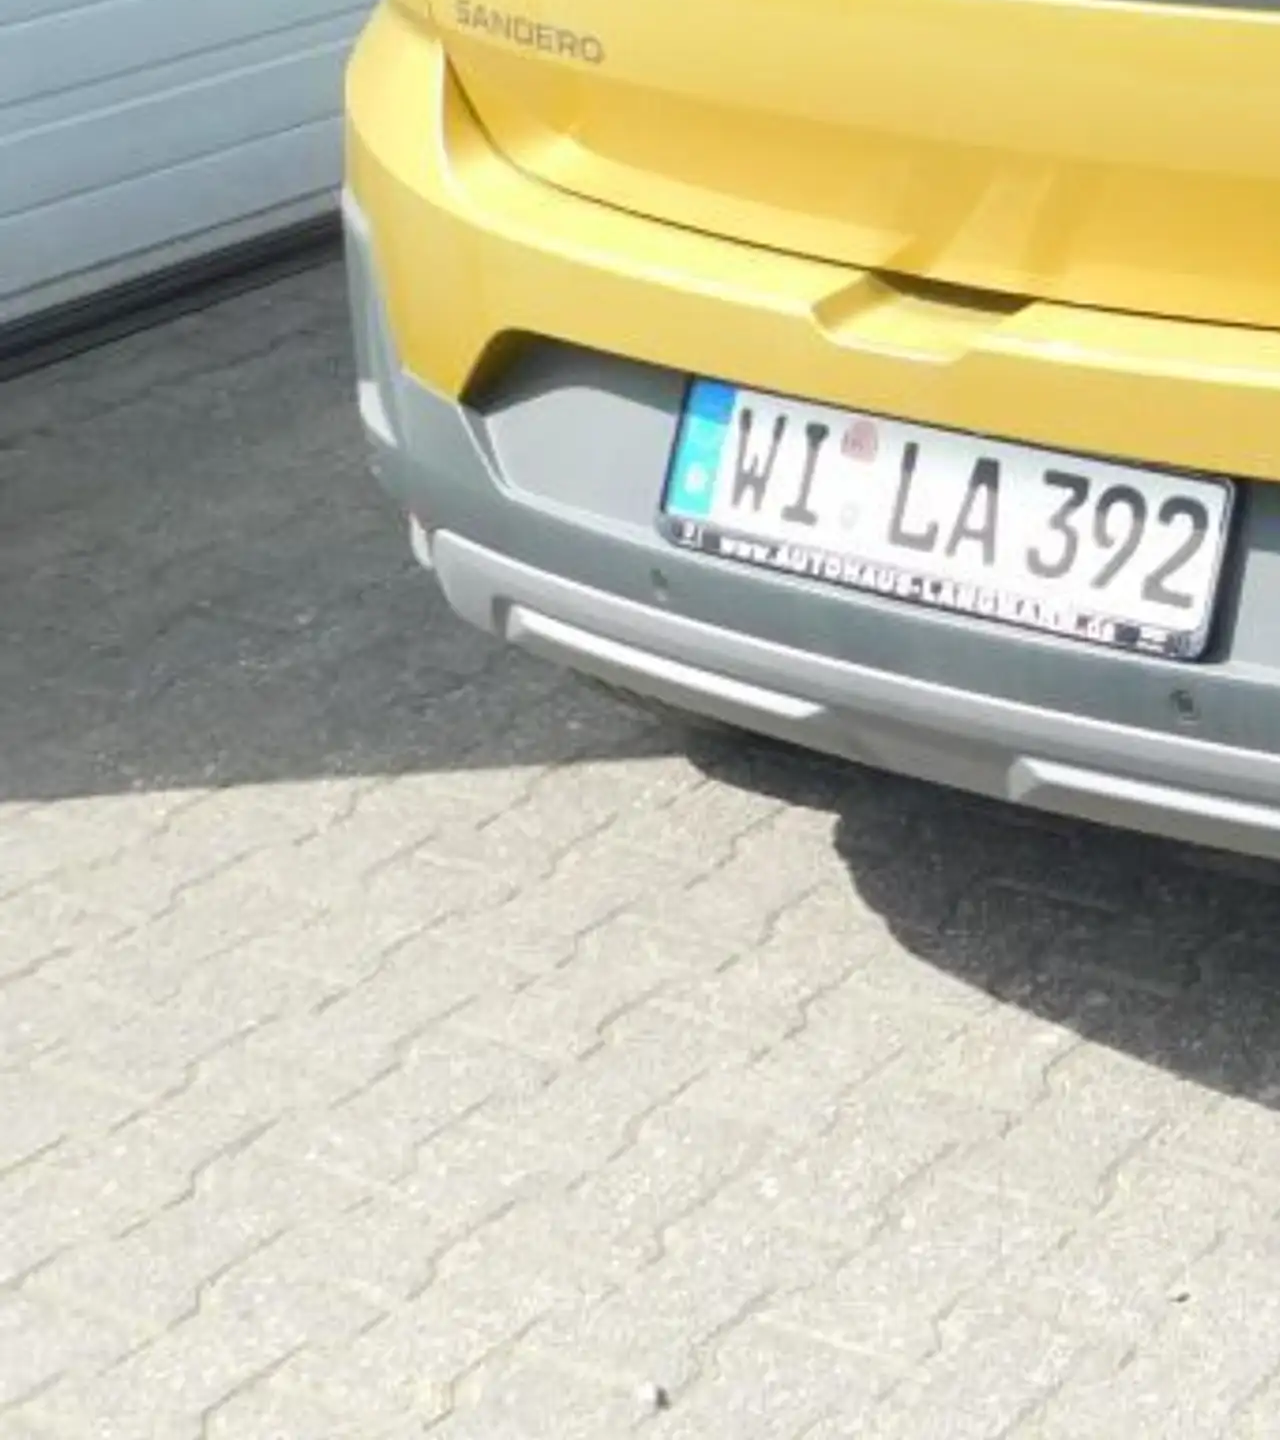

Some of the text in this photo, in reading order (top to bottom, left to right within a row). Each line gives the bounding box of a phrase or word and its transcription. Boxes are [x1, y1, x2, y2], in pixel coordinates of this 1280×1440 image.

[731, 407, 1210, 609] WI LA 392
